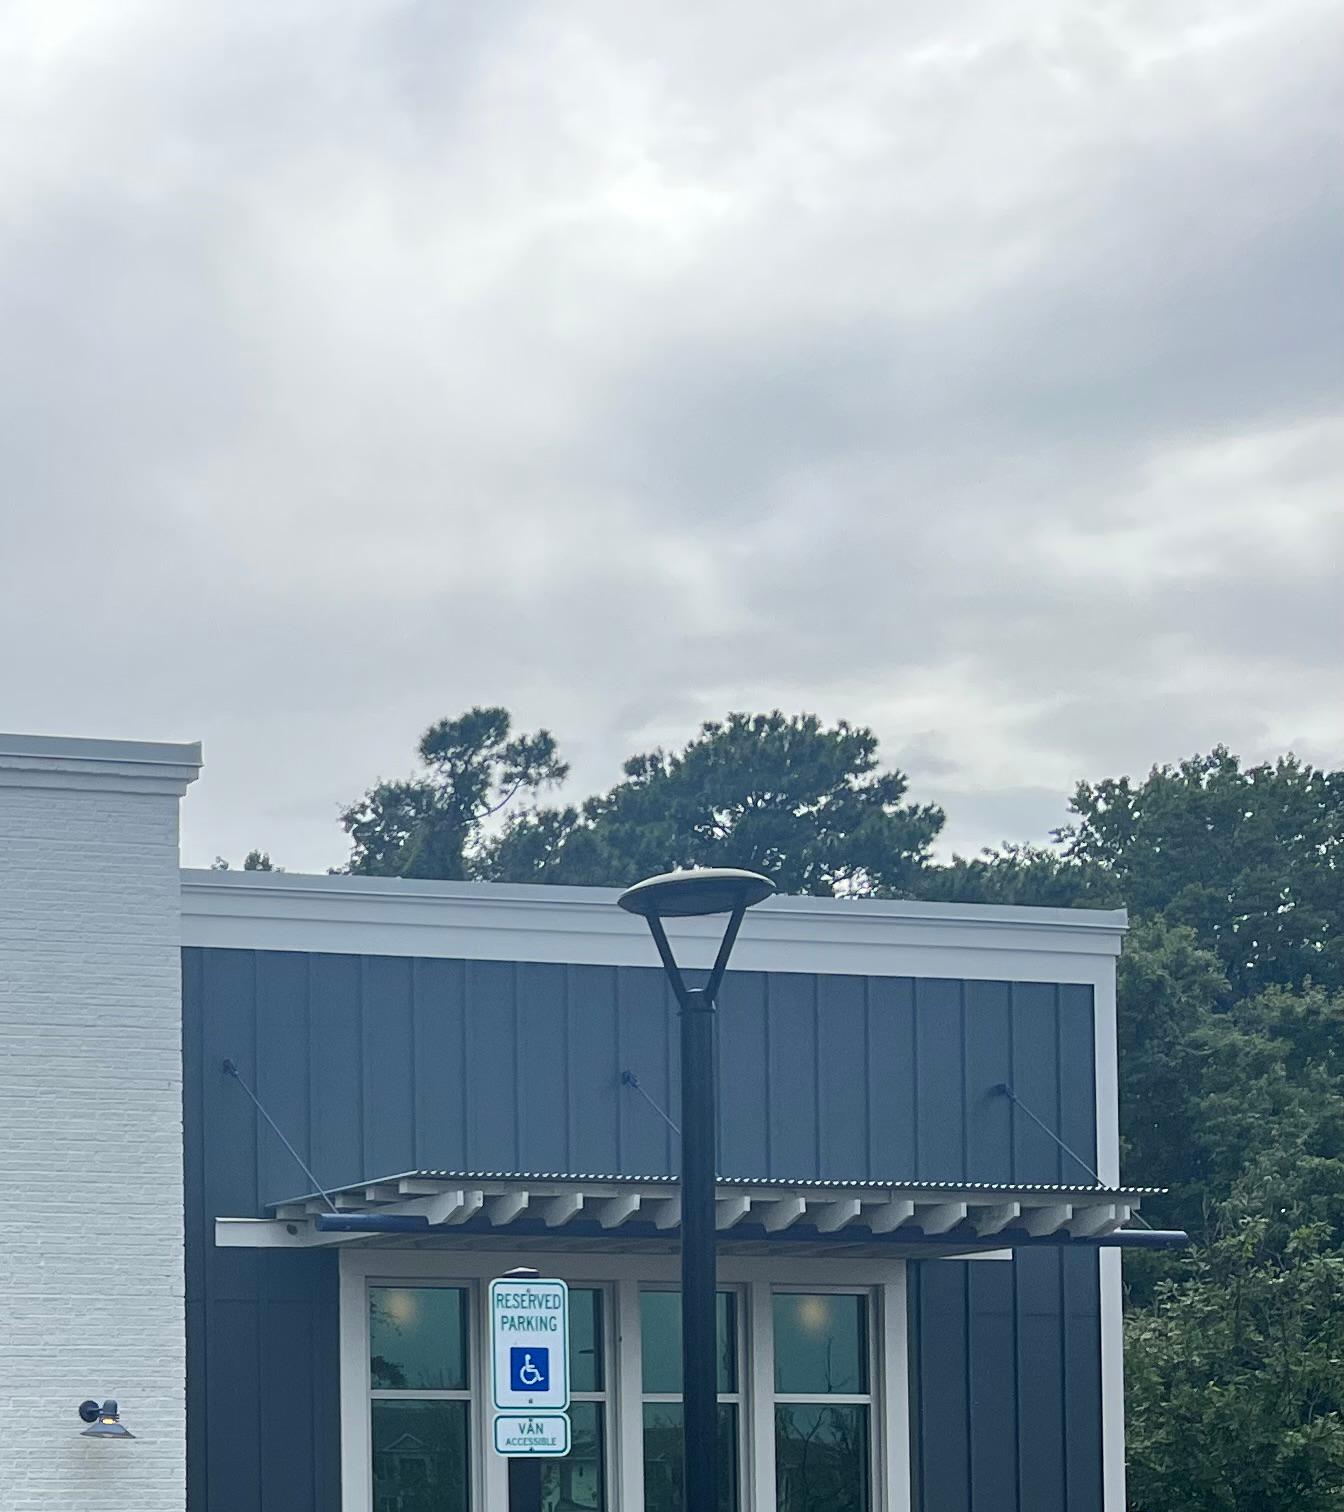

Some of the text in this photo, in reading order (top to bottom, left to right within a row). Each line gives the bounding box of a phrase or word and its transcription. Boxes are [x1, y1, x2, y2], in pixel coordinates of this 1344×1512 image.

[495, 1292, 562, 1311] RESERVED
[500, 1315, 558, 1333] PARKING
[518, 1422, 545, 1436] VAN
[505, 1437, 557, 1446] ACCESSIBLE
